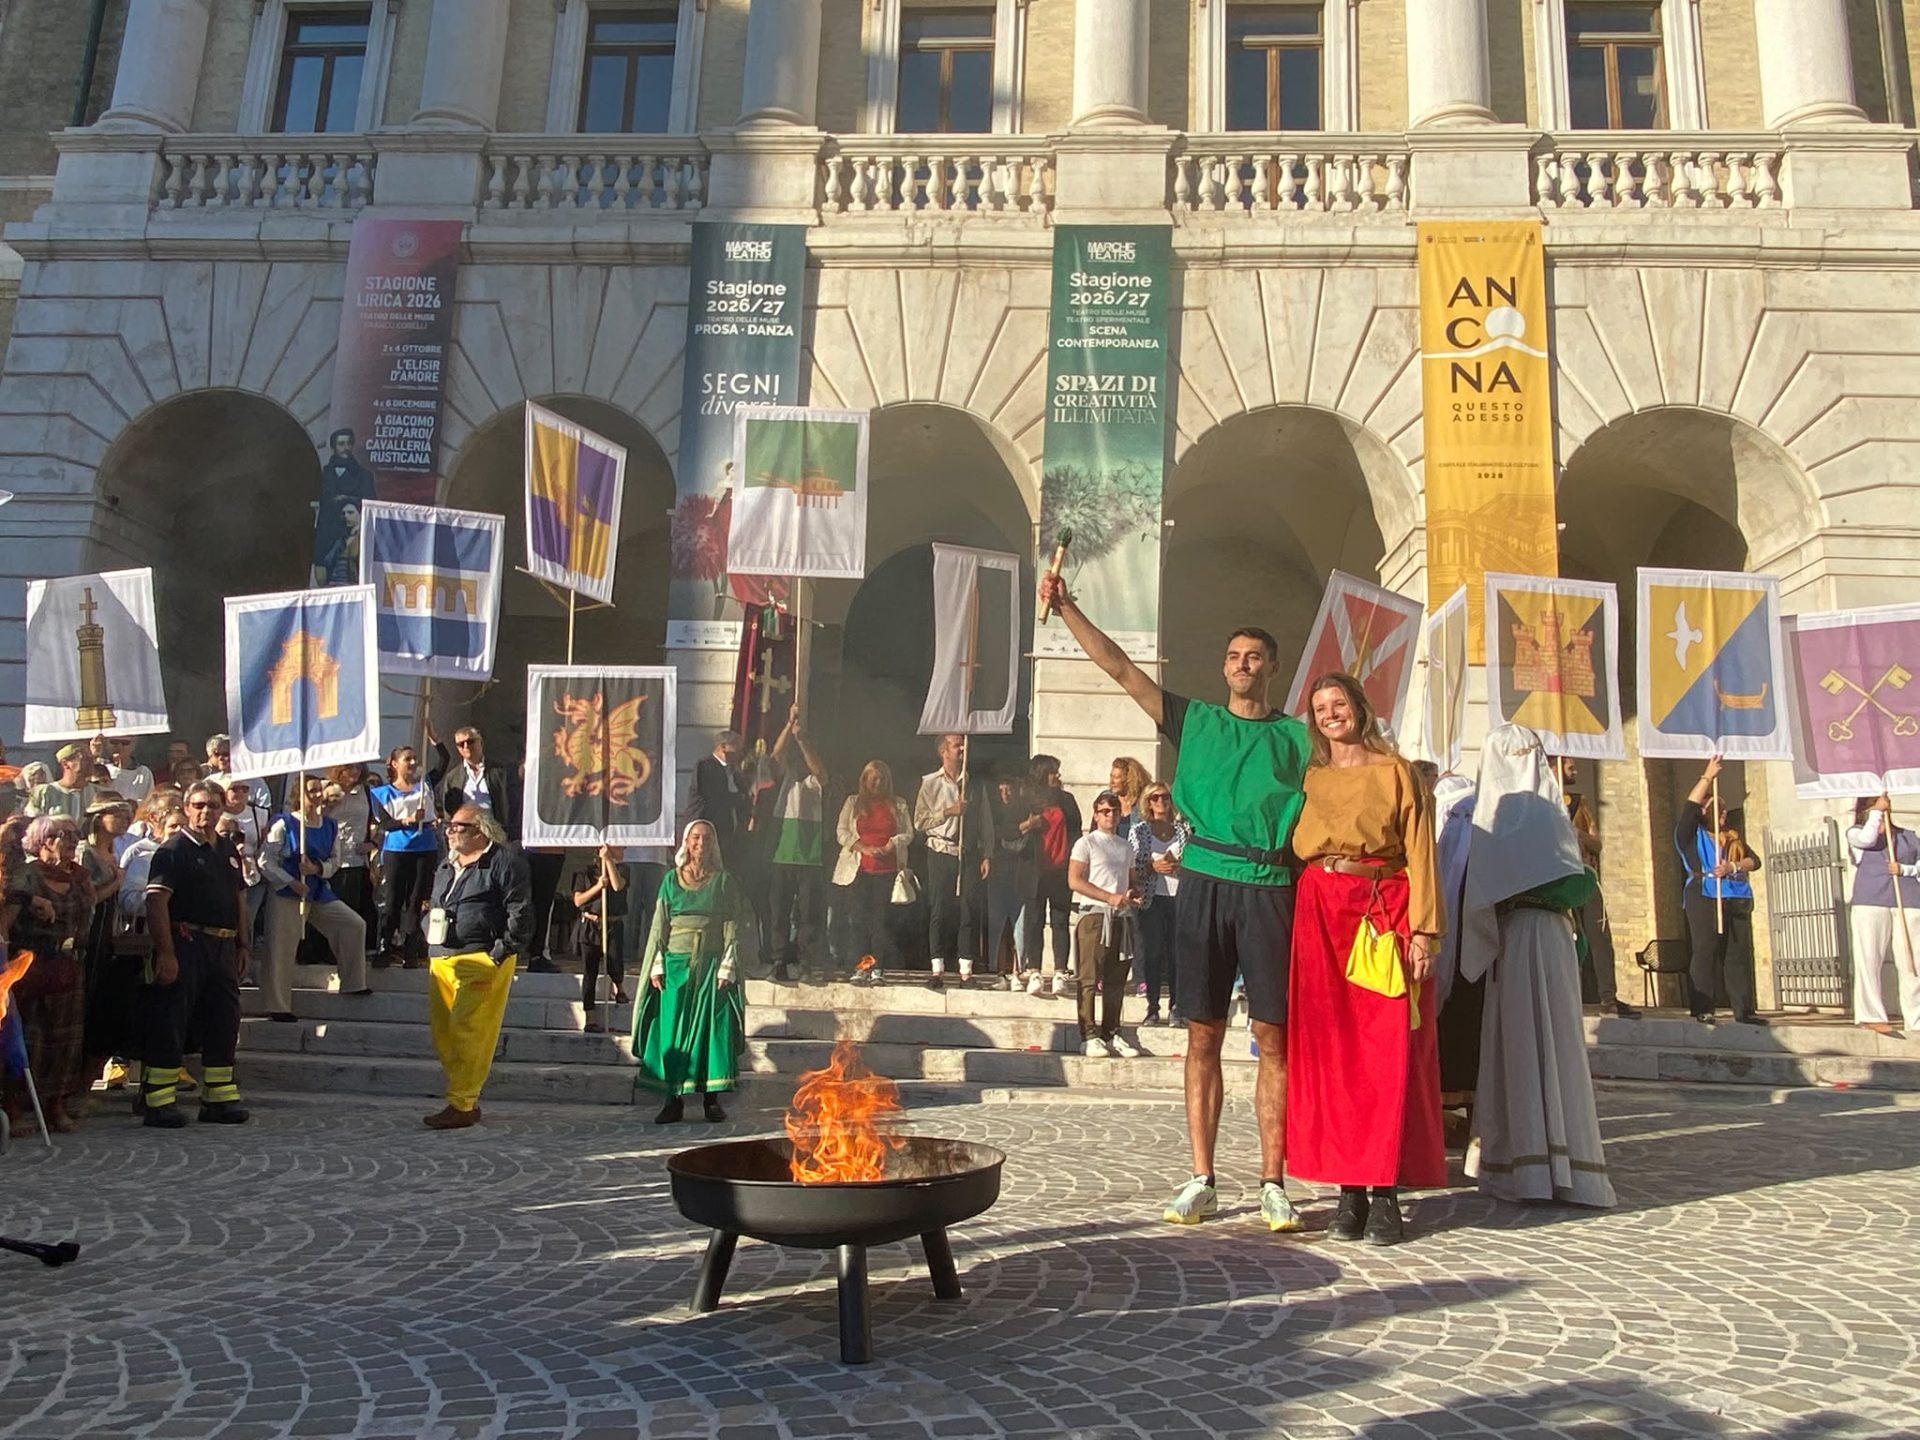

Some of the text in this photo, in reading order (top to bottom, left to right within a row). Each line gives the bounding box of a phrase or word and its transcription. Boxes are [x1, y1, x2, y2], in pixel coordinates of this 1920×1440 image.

[725, 241, 772, 252] MARCHE
[1088, 242, 1136, 252] MARCHE
[726, 250, 771, 259] TEATRO
[1089, 250, 1136, 260] TEATRO
[365, 276, 437, 291] STAGIONE
[1070, 272, 1152, 290] Stagione
[706, 280, 786, 297] Stagione
[1447, 276, 1517, 308] AN
[357, 293, 441, 309] LIRICA 2026
[1070, 290, 1151, 308] 2026/27
[706, 298, 785, 315] 2026/27
[694, 323, 794, 336] PROSA DANZA
[1089, 326, 1127, 336] SCENA
[402, 344, 442, 353] OTTOBRE
[1057, 338, 1159, 349] CONTEMPORANEA
[397, 359, 440, 371] L'ELISIR
[390, 370, 439, 382] D'AMORE
[1451, 361, 1521, 393] NA
[702, 373, 780, 395] SEGNI
[1055, 375, 1157, 392] SPAZI DI
[392, 400, 437, 409] DICEMBRE
[1053, 392, 1157, 408] CREATIVITÀ
[1452, 402, 1523, 412] QUESTO
[375, 414, 434, 427] A GIACOMO
[1054, 408, 1156, 424] ILLIMITATA
[1452, 413, 1524, 422] ADESSO
[366, 439, 431, 452] CAVALLERIA
[370, 451, 430, 464] RUSTICANA
